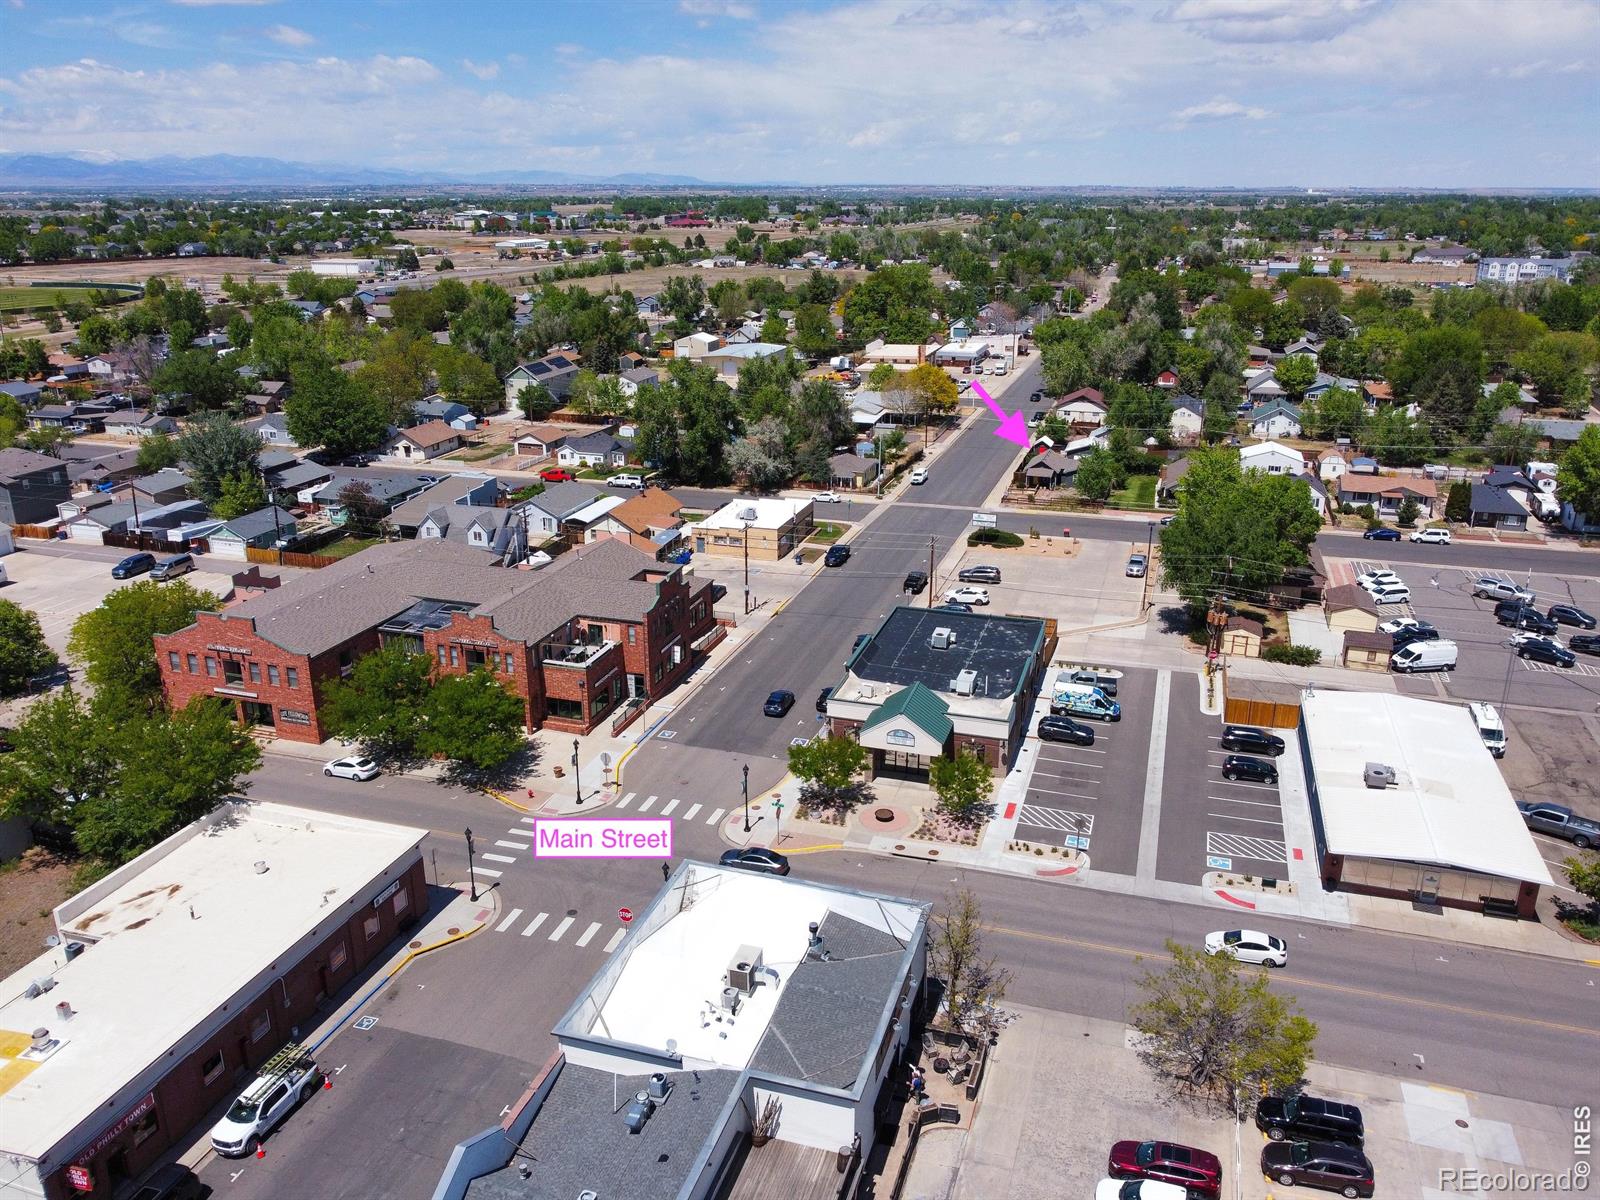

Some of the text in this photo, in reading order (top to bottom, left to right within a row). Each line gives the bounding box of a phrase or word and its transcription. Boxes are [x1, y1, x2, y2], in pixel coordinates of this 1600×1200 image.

[79, 1103, 147, 1165] OLD PHILLY TOWN
